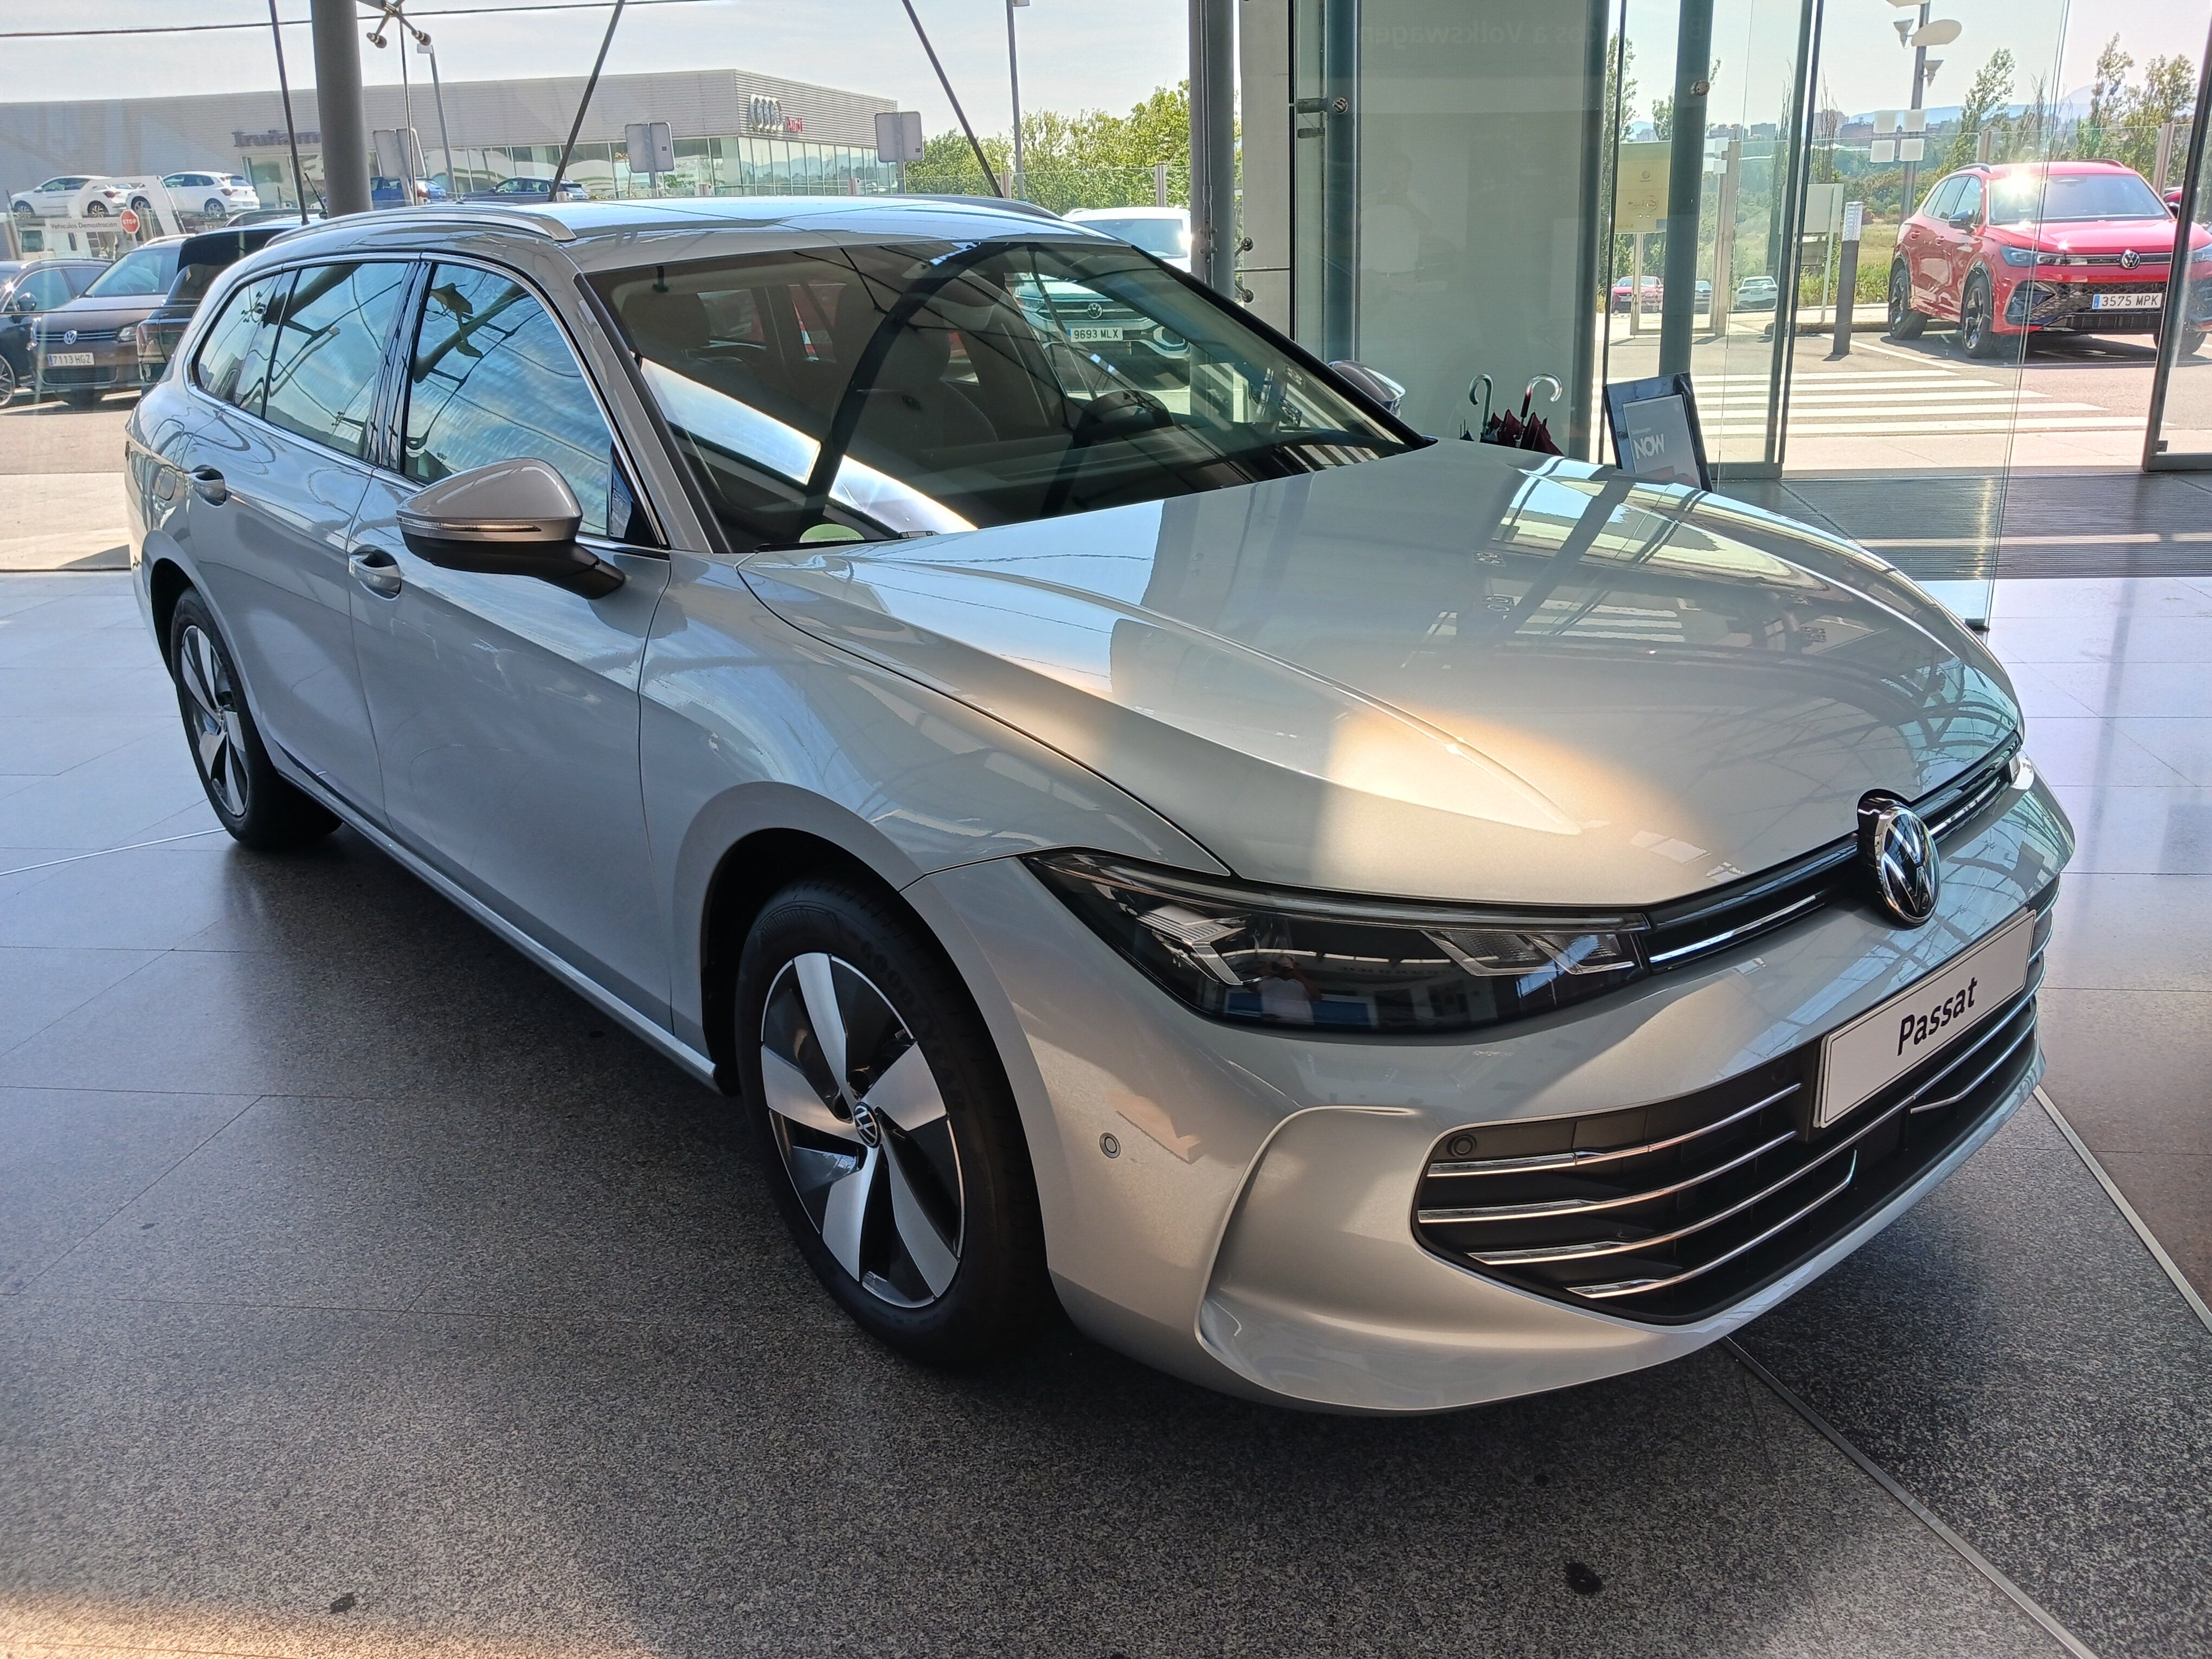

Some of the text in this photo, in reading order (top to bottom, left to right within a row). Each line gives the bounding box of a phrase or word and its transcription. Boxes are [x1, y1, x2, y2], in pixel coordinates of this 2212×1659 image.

[2101, 294, 2158, 307] 3575 MPK
[1074, 329, 1118, 339] 9693 MLX
[53, 354, 91, 365] 7113 HGZ
[1633, 433, 1664, 459] NOW
[1897, 977, 1978, 1057] Passat
